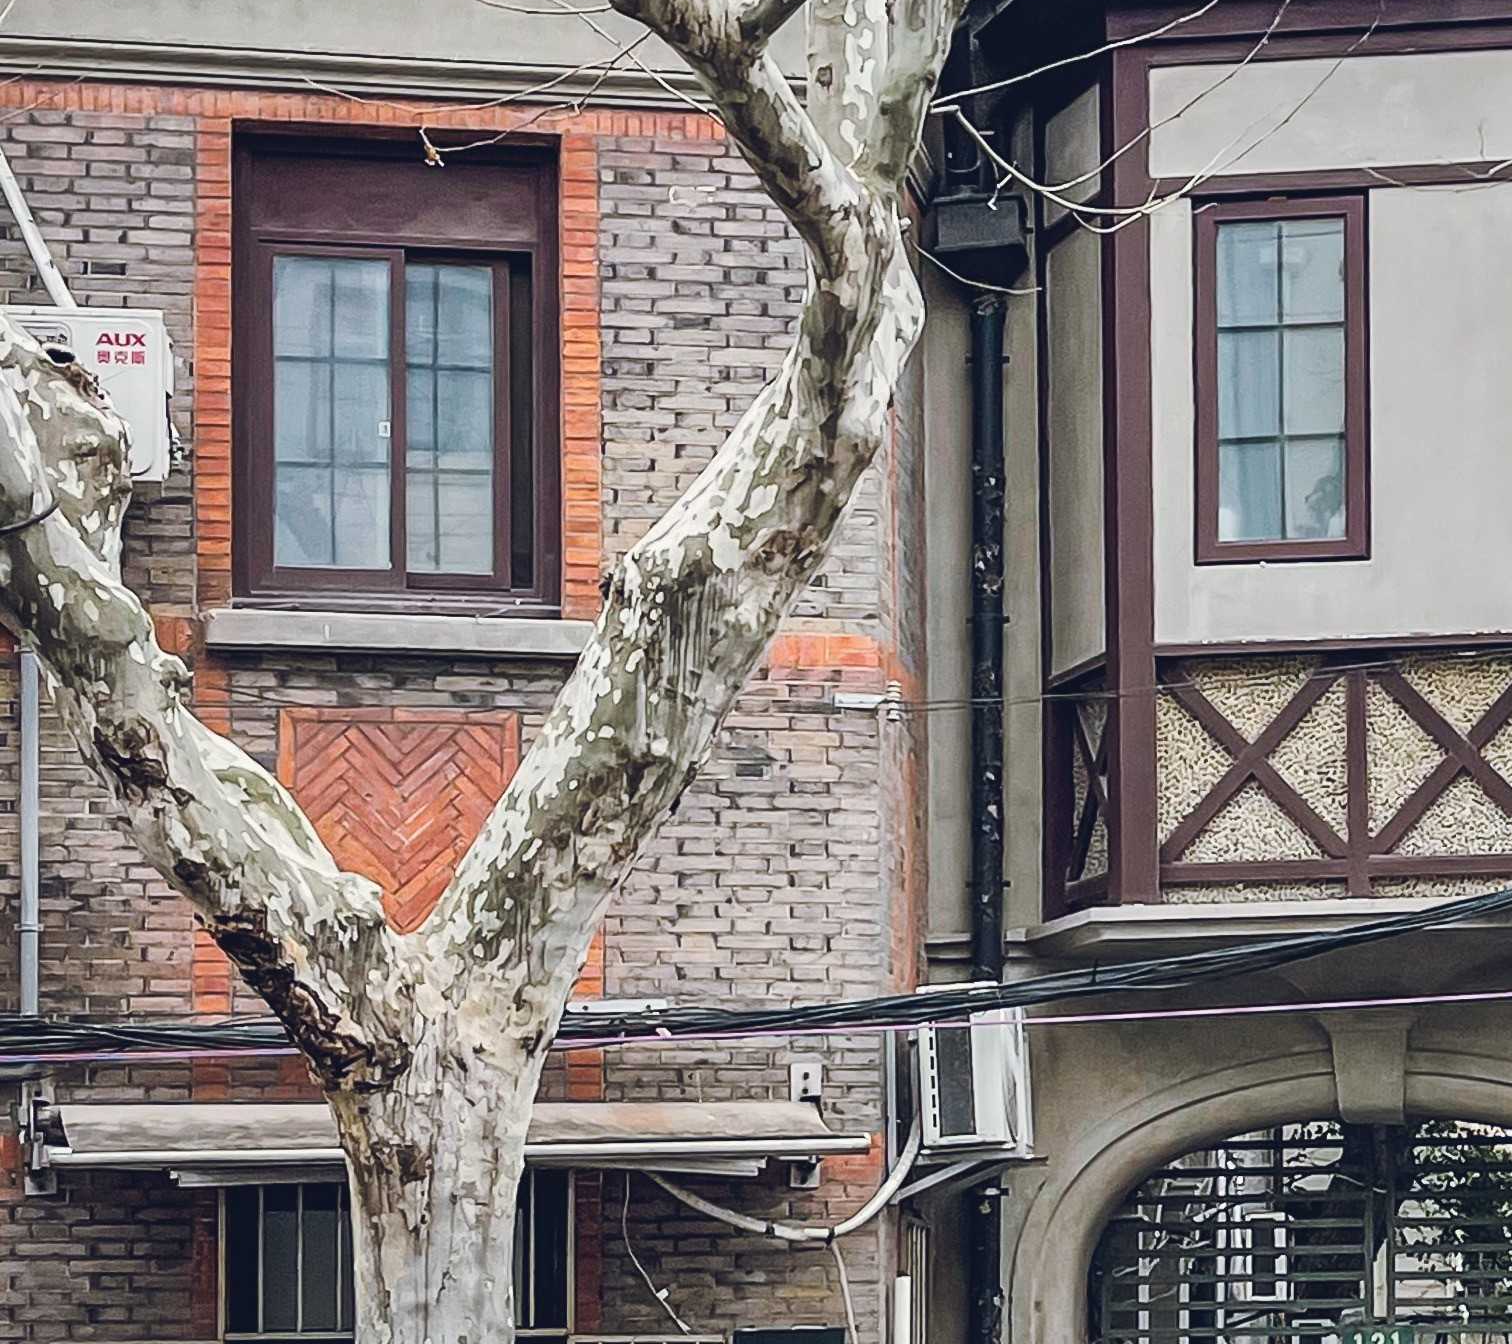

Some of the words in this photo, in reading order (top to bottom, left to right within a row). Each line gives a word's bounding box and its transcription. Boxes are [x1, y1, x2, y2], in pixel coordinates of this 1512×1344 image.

[96, 333, 146, 346] AUX
[97, 350, 145, 364] 奥克斯
